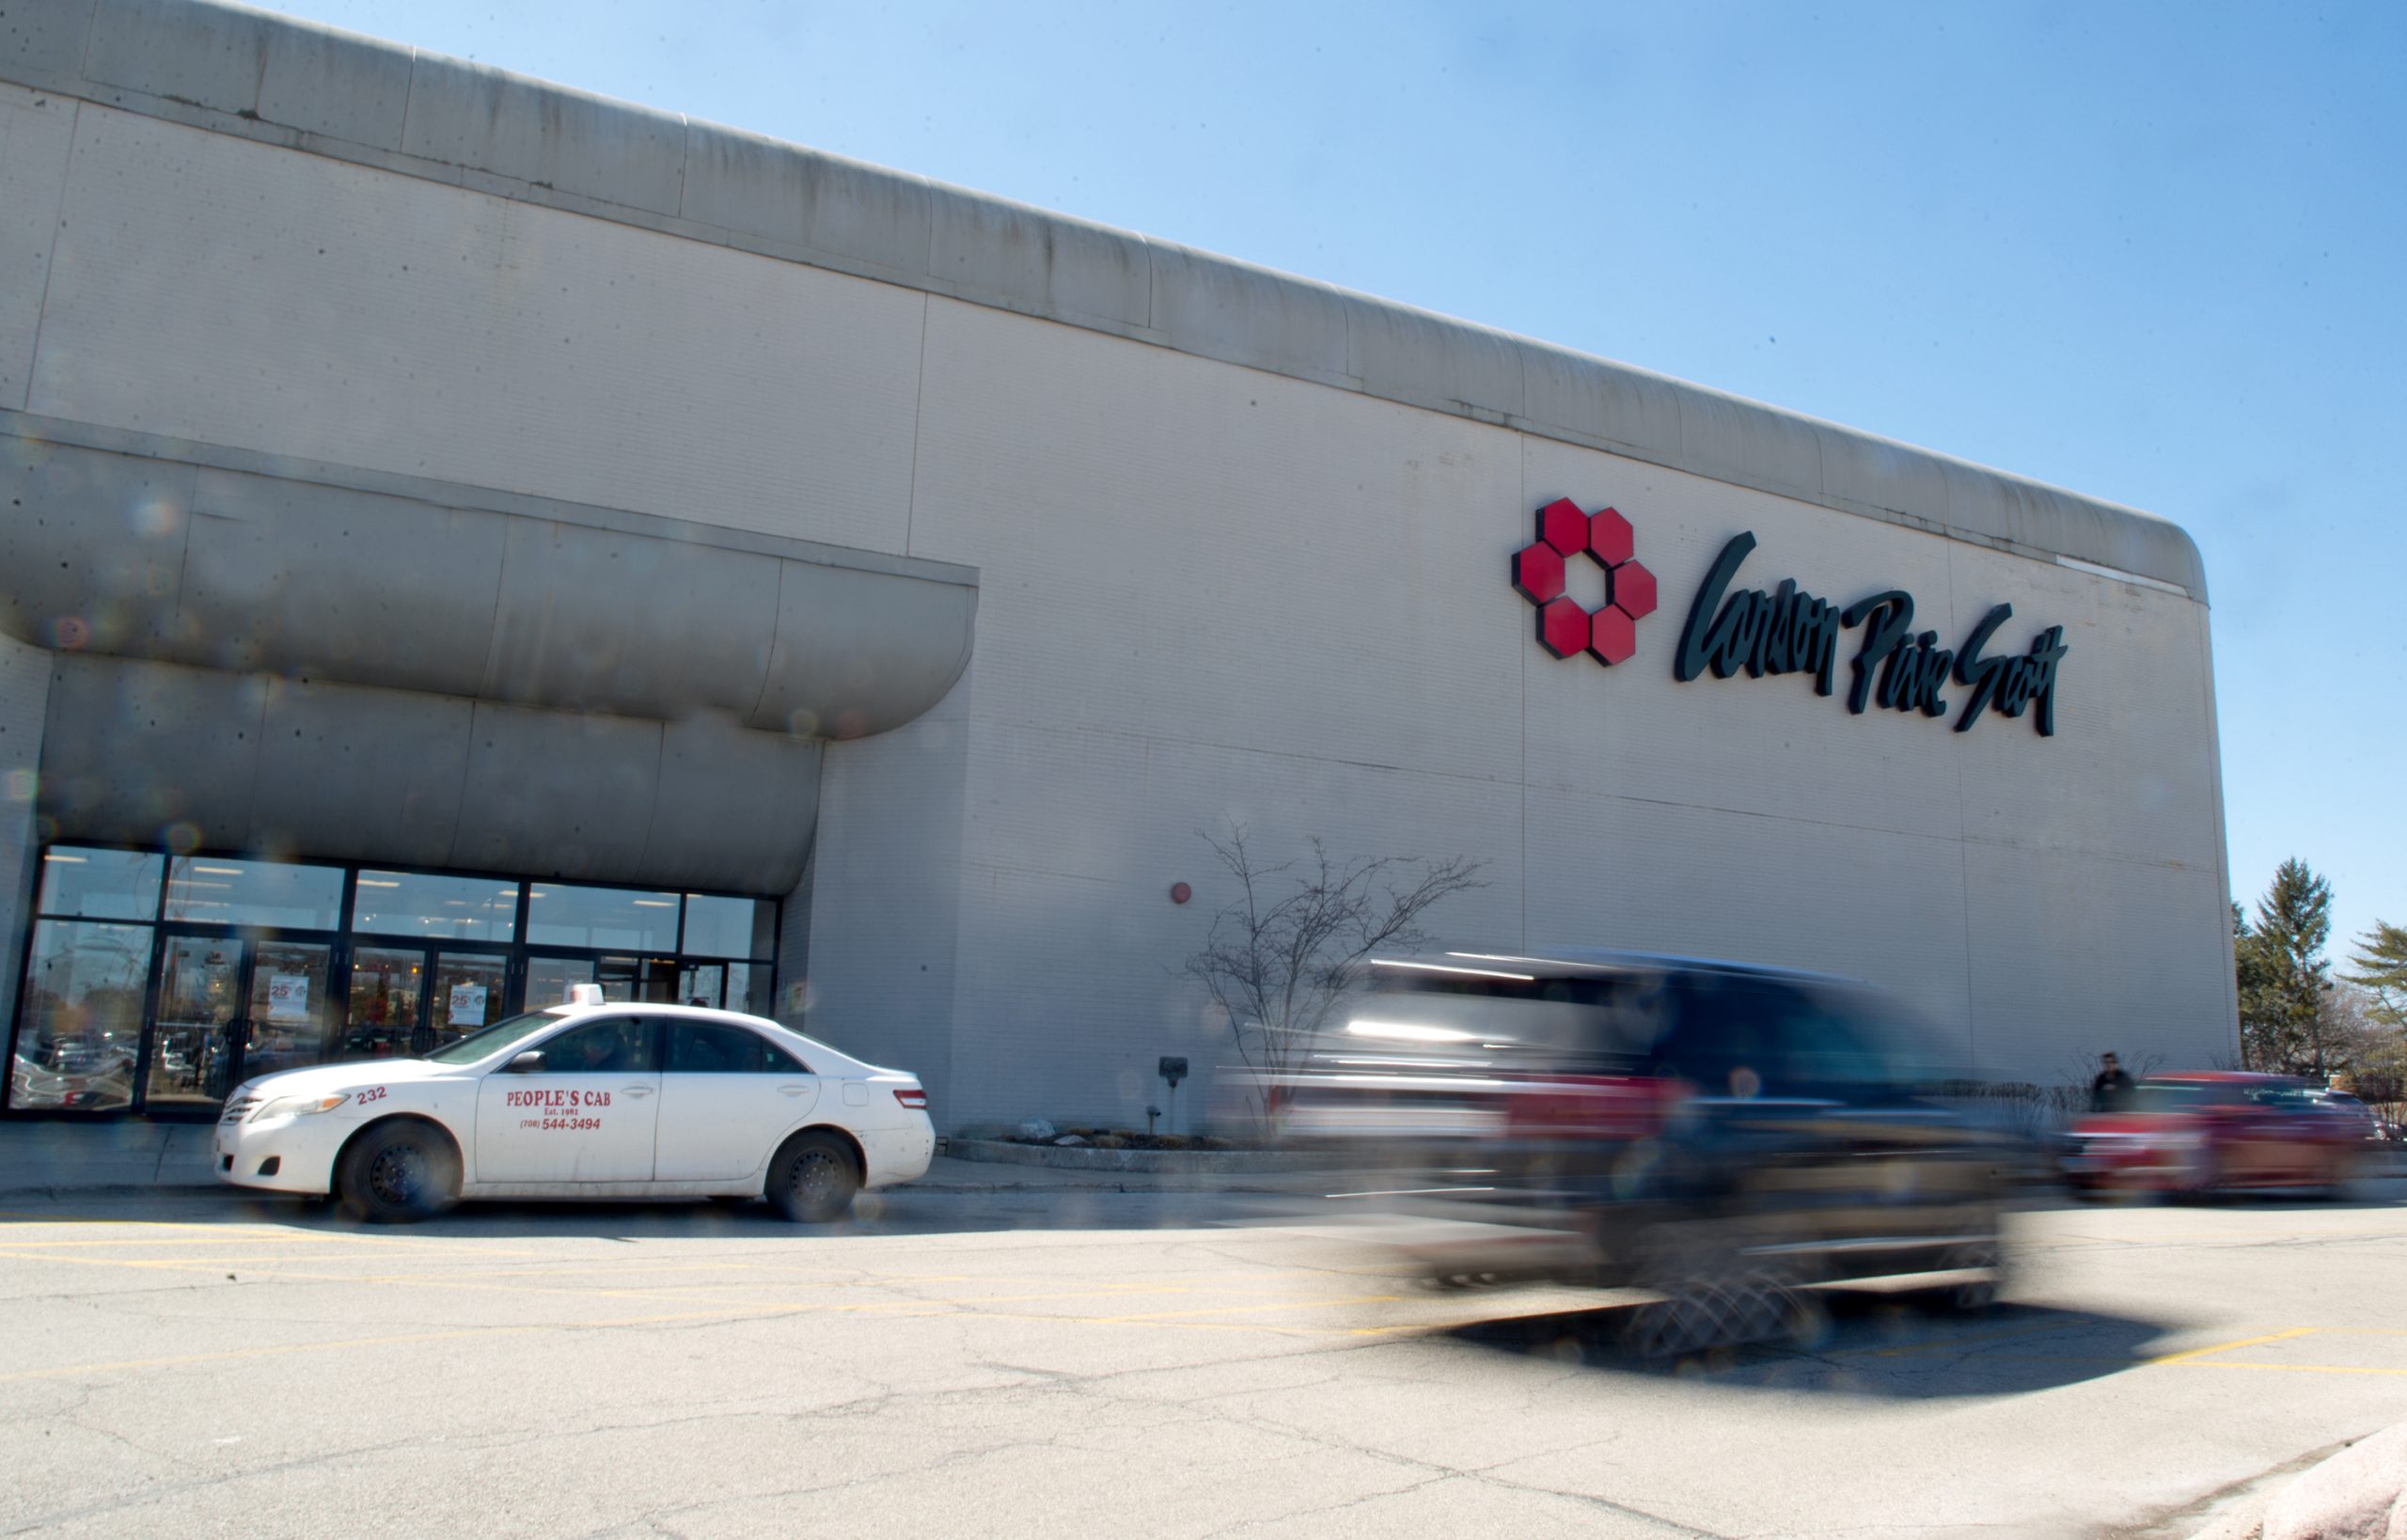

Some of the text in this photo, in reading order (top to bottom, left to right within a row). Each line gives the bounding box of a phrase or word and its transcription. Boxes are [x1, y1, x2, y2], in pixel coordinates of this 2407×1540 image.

[1841, 589, 1954, 715] Pirie
[1952, 602, 2069, 737] Scott
[356, 1086, 387, 1106] 232
[507, 1090, 611, 1107] PEOPLE'S CAB
[520, 1118, 601, 1130] (708) 544-3494
